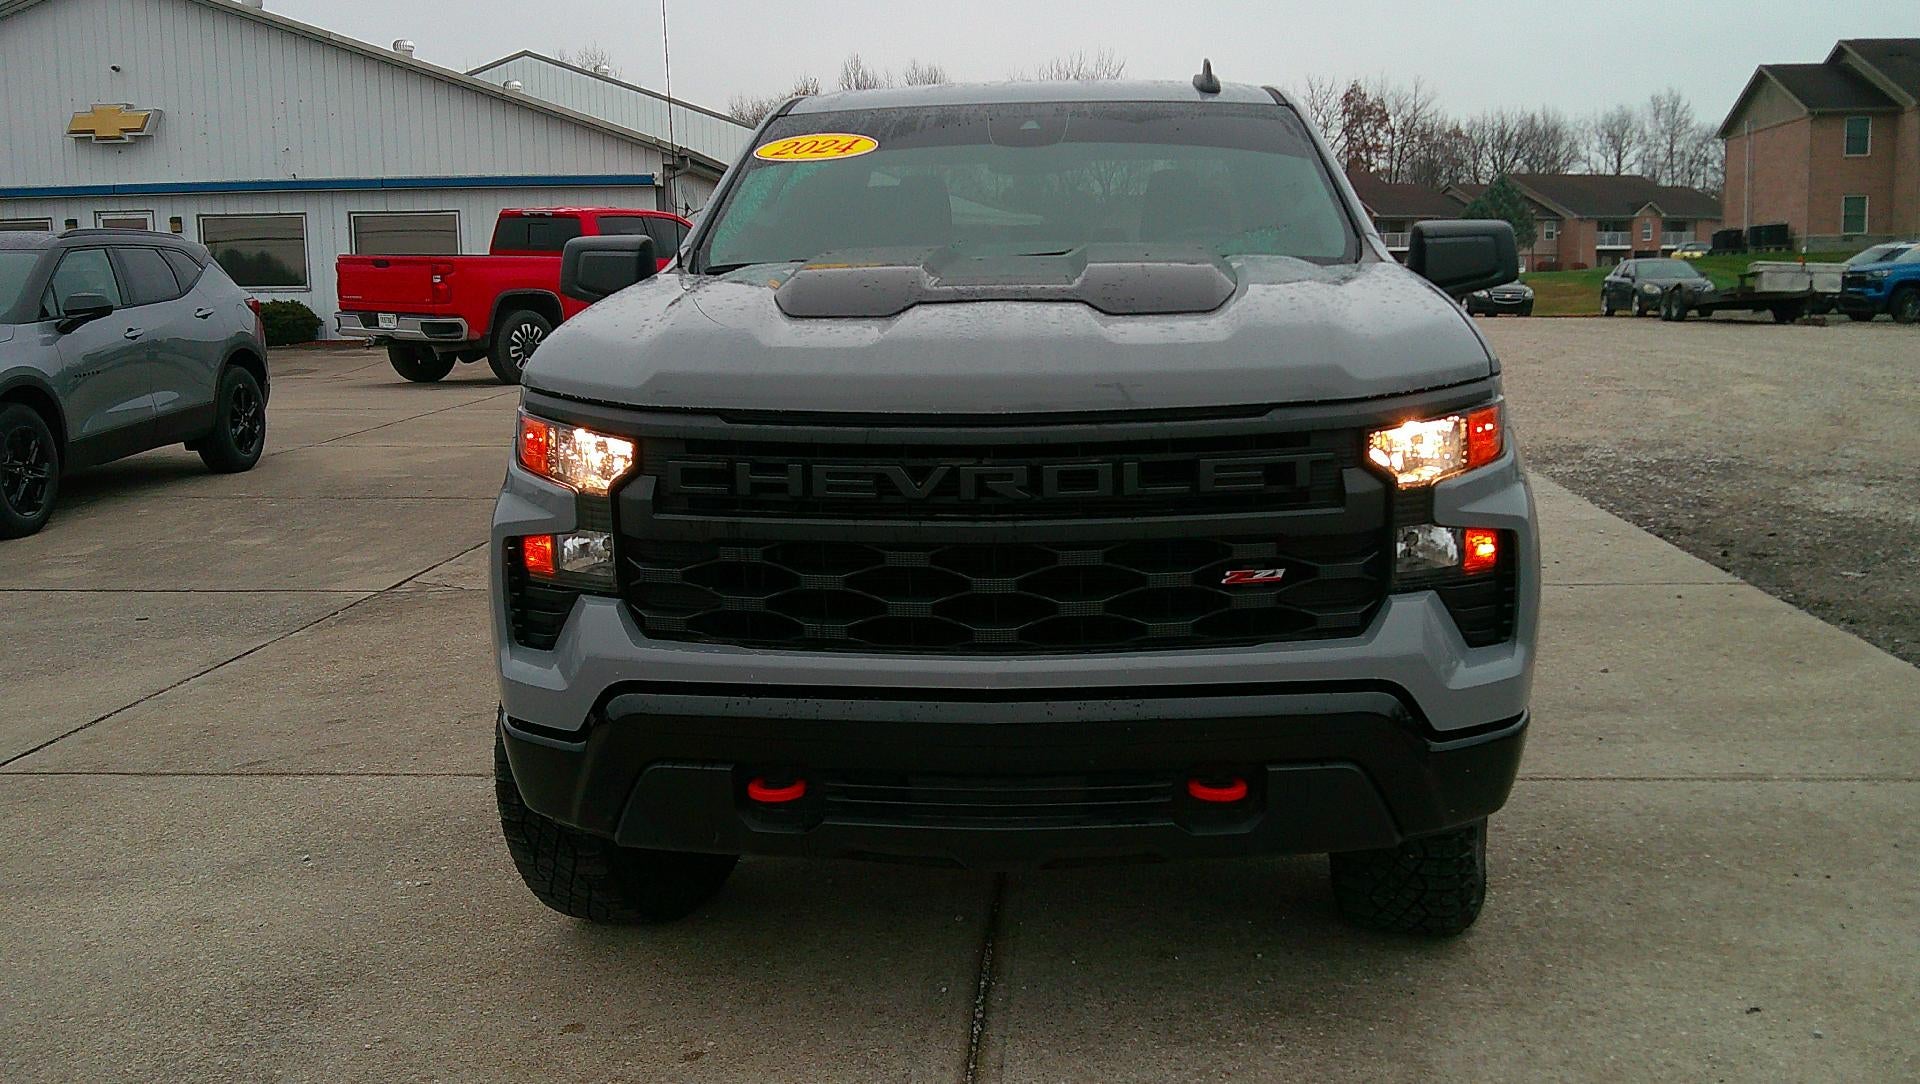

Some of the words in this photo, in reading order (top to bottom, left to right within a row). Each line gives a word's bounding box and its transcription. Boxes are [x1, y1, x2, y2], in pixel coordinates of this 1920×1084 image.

[773, 139, 861, 156] 2024
[667, 451, 1337, 501] CHEVROLET
[1221, 568, 1286, 584] Z71
